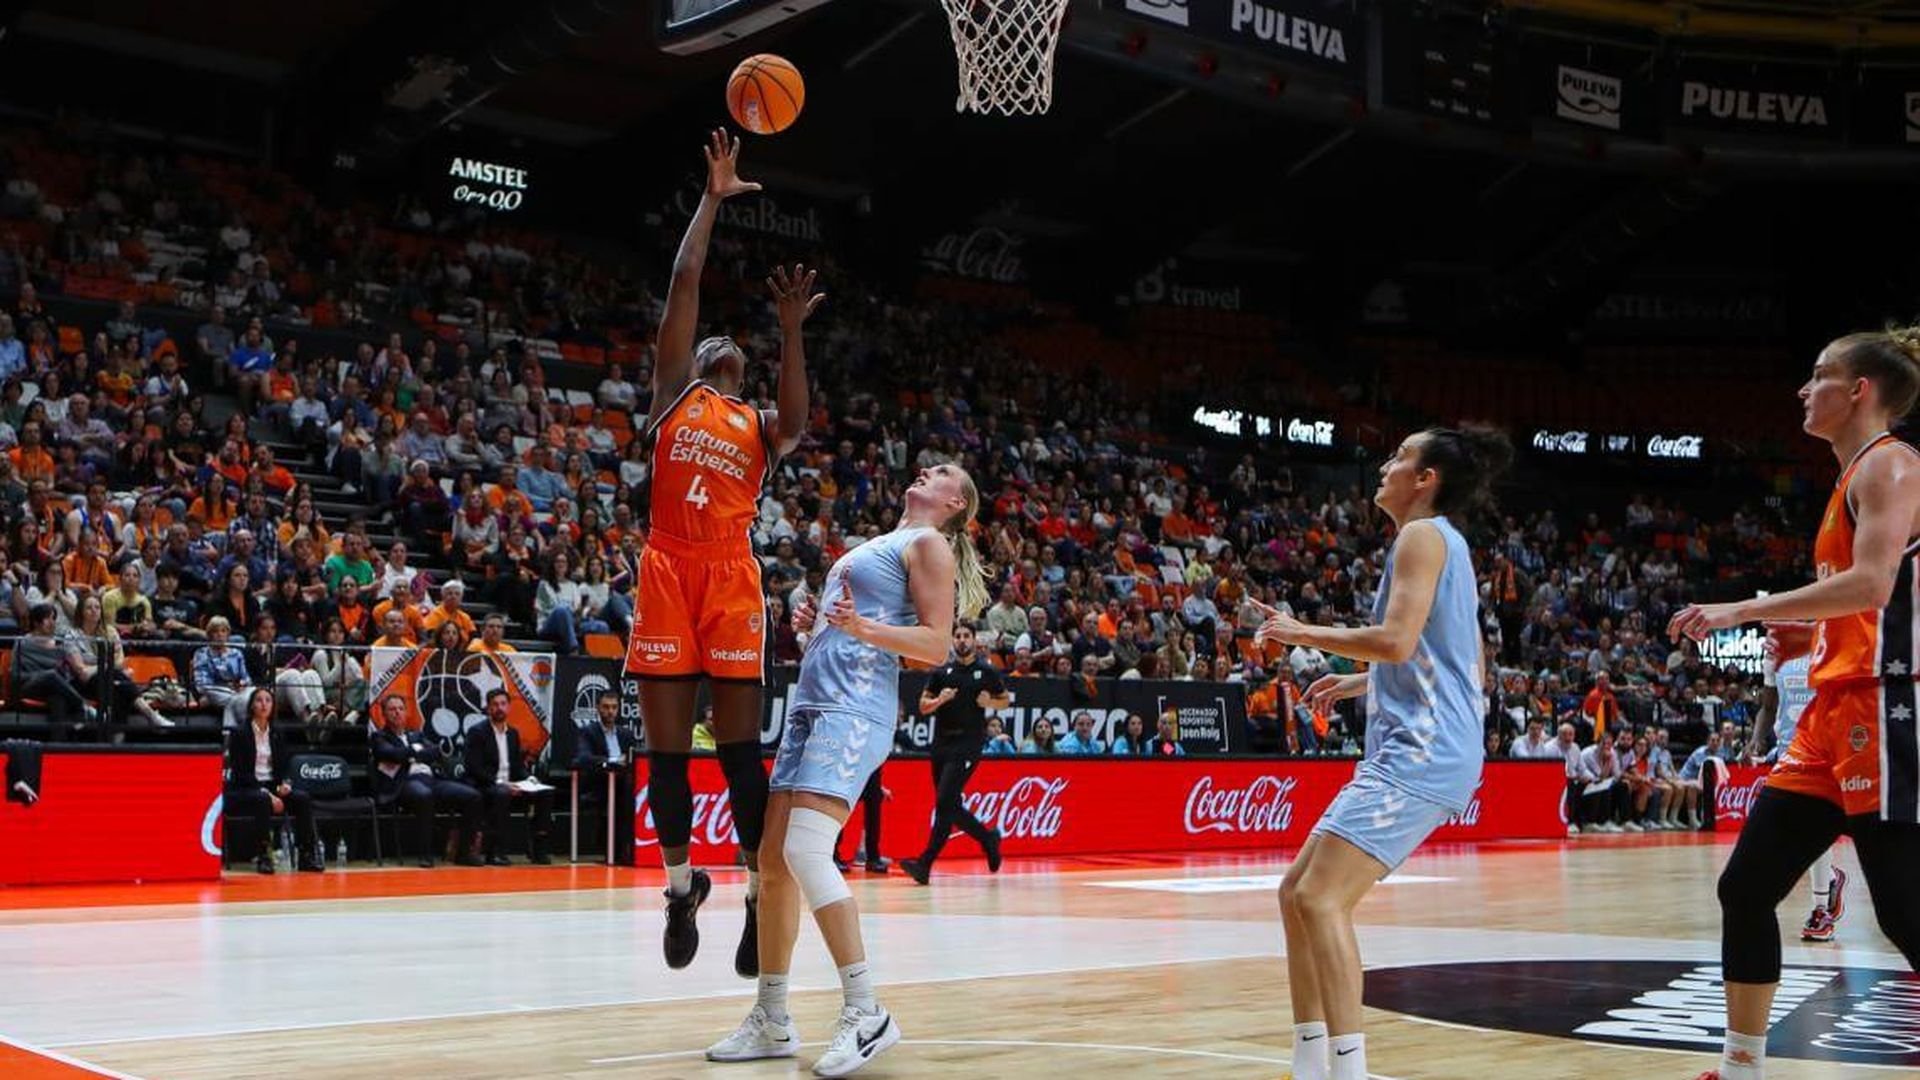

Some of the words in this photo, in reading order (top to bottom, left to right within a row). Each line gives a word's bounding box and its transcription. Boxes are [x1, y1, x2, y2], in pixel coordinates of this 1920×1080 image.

[1230, 0, 1347, 63] PULEVA
[1562, 74, 1617, 99] PULEVA
[1681, 80, 1828, 126] PULEVA
[450, 156, 528, 189] AMSTEL
[1170, 286, 1240, 309] travel
[675, 426, 739, 458] Cultura
[669, 442, 745, 480] Esfuerzo
[685, 474, 709, 510] 4
[636, 640, 677, 653] PULEVA
[1184, 776, 1298, 833] Coca-Cola
